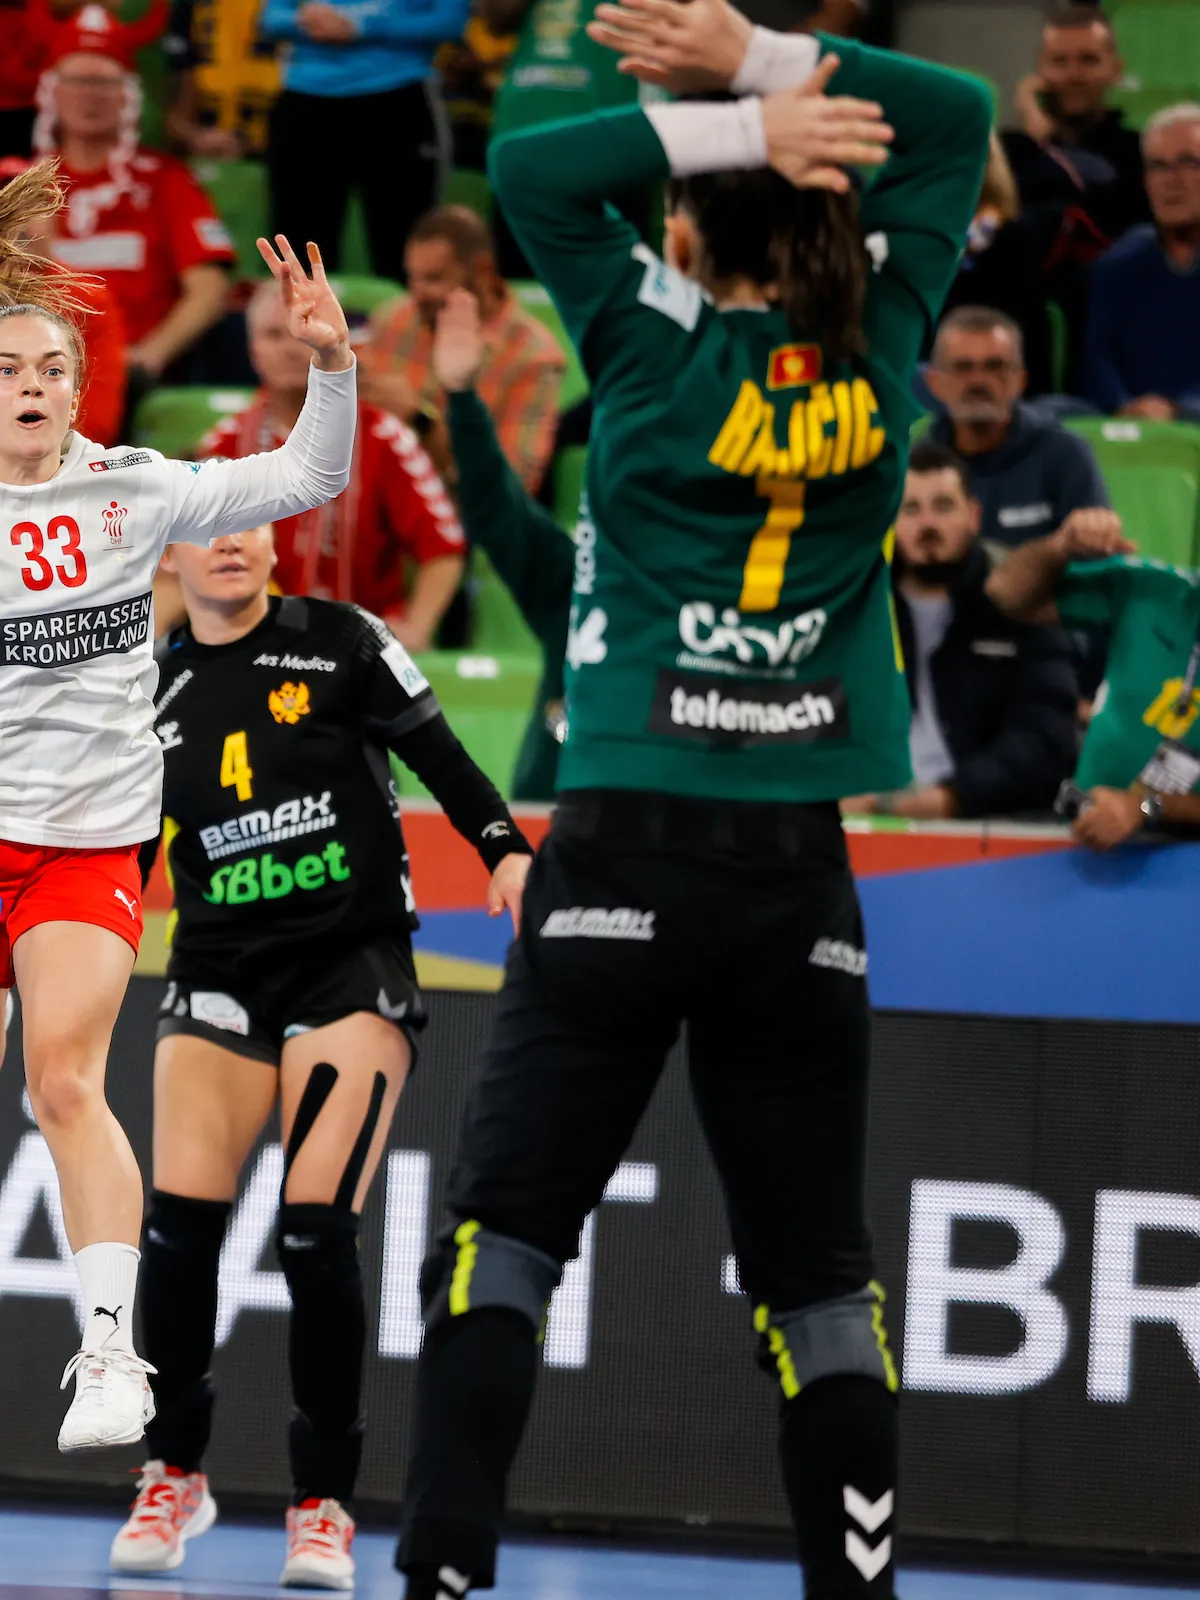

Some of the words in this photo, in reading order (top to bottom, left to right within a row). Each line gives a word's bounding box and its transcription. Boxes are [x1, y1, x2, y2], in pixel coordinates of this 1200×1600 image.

[9, 515, 88, 592] 33
[2, 596, 151, 642] SPAREKASSEN
[4, 619, 148, 664] KRONJYLLAND
[252, 652, 280, 668] Ars
[279, 652, 338, 673] Medica
[670, 685, 836, 734] telemach
[219, 730, 254, 802] 4
[199, 789, 333, 851] BEMAX
